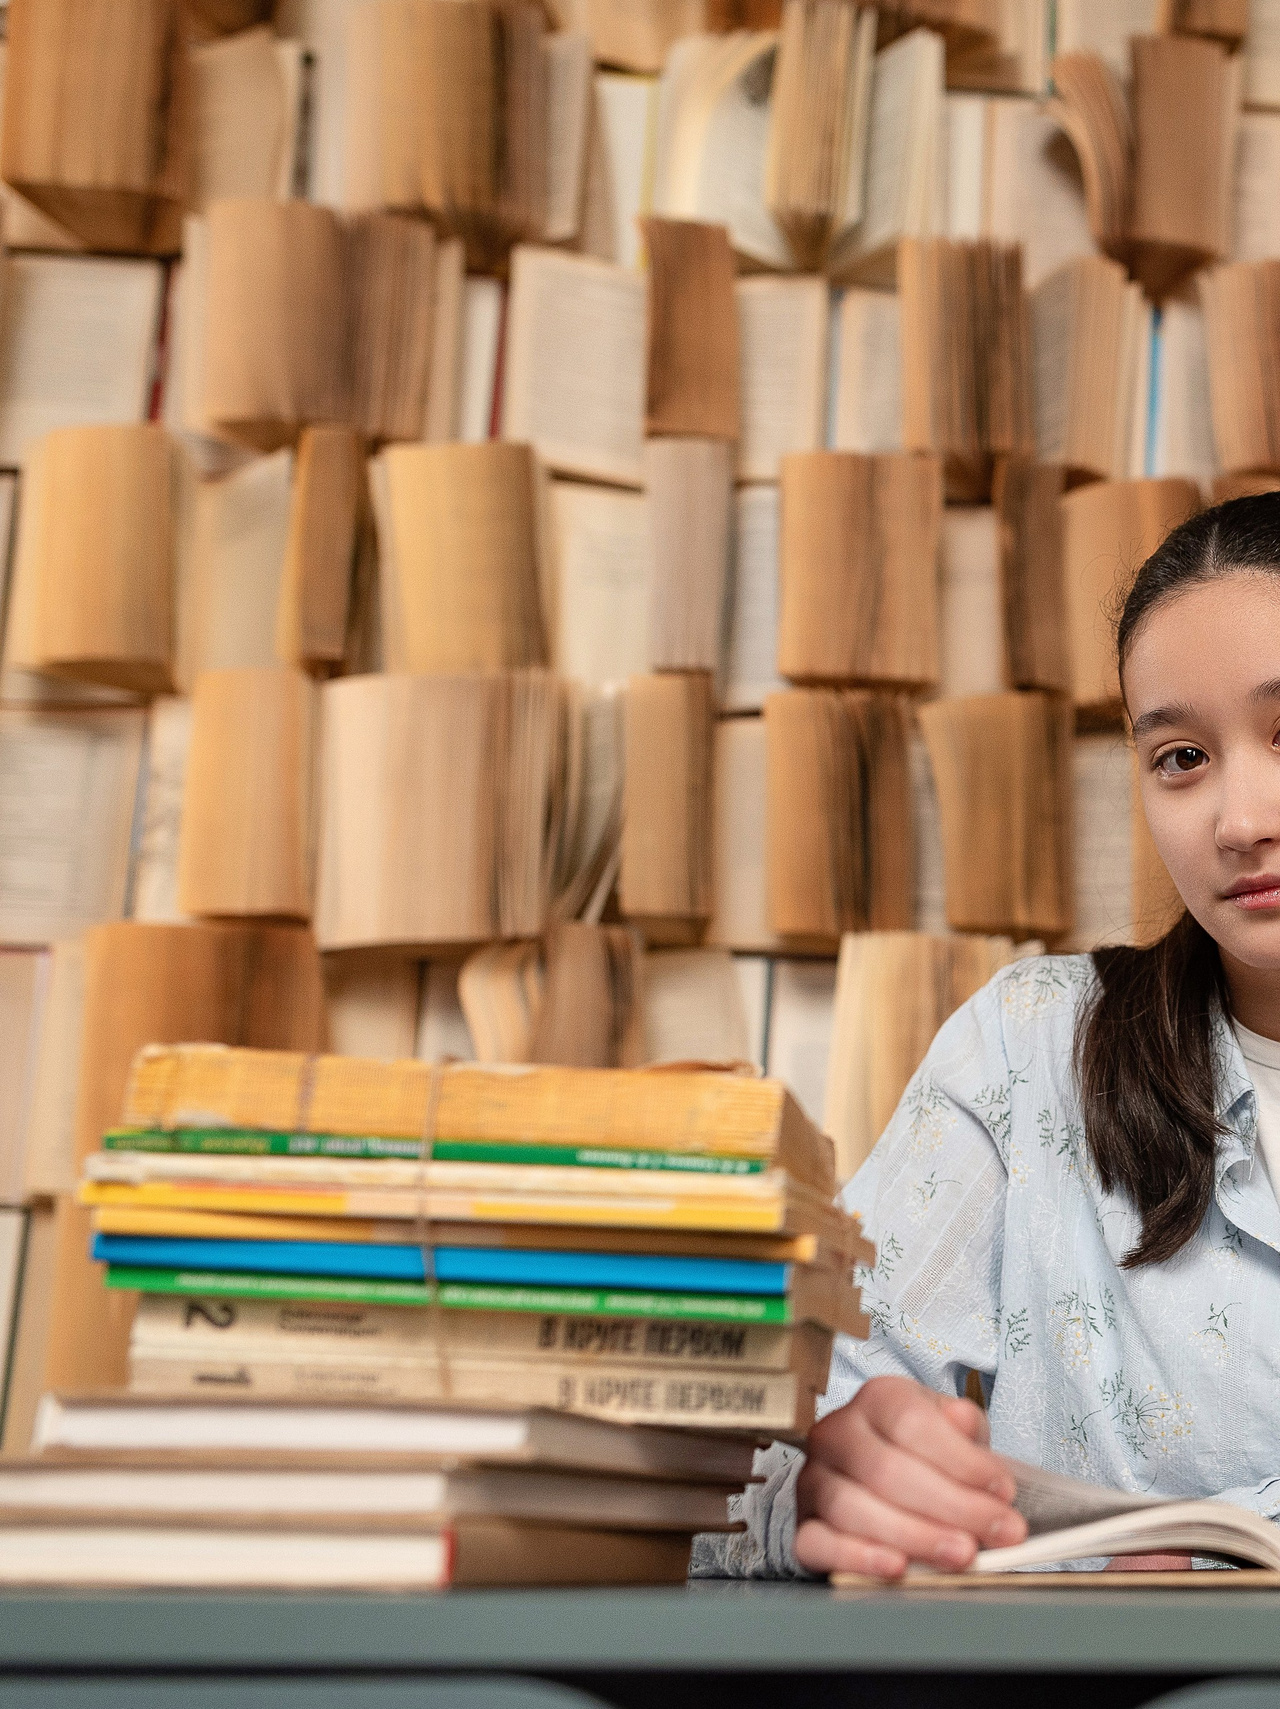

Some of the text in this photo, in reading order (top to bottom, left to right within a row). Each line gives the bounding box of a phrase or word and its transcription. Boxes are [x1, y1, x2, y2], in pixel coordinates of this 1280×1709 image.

[184, 1300, 237, 1330] 2
[538, 1316, 747, 1360] В КРУГЕ ПЕРВОМ
[193, 1366, 252, 1387] 1
[558, 1377, 768, 1416] В КРУГЕ ПЕРВОМ
